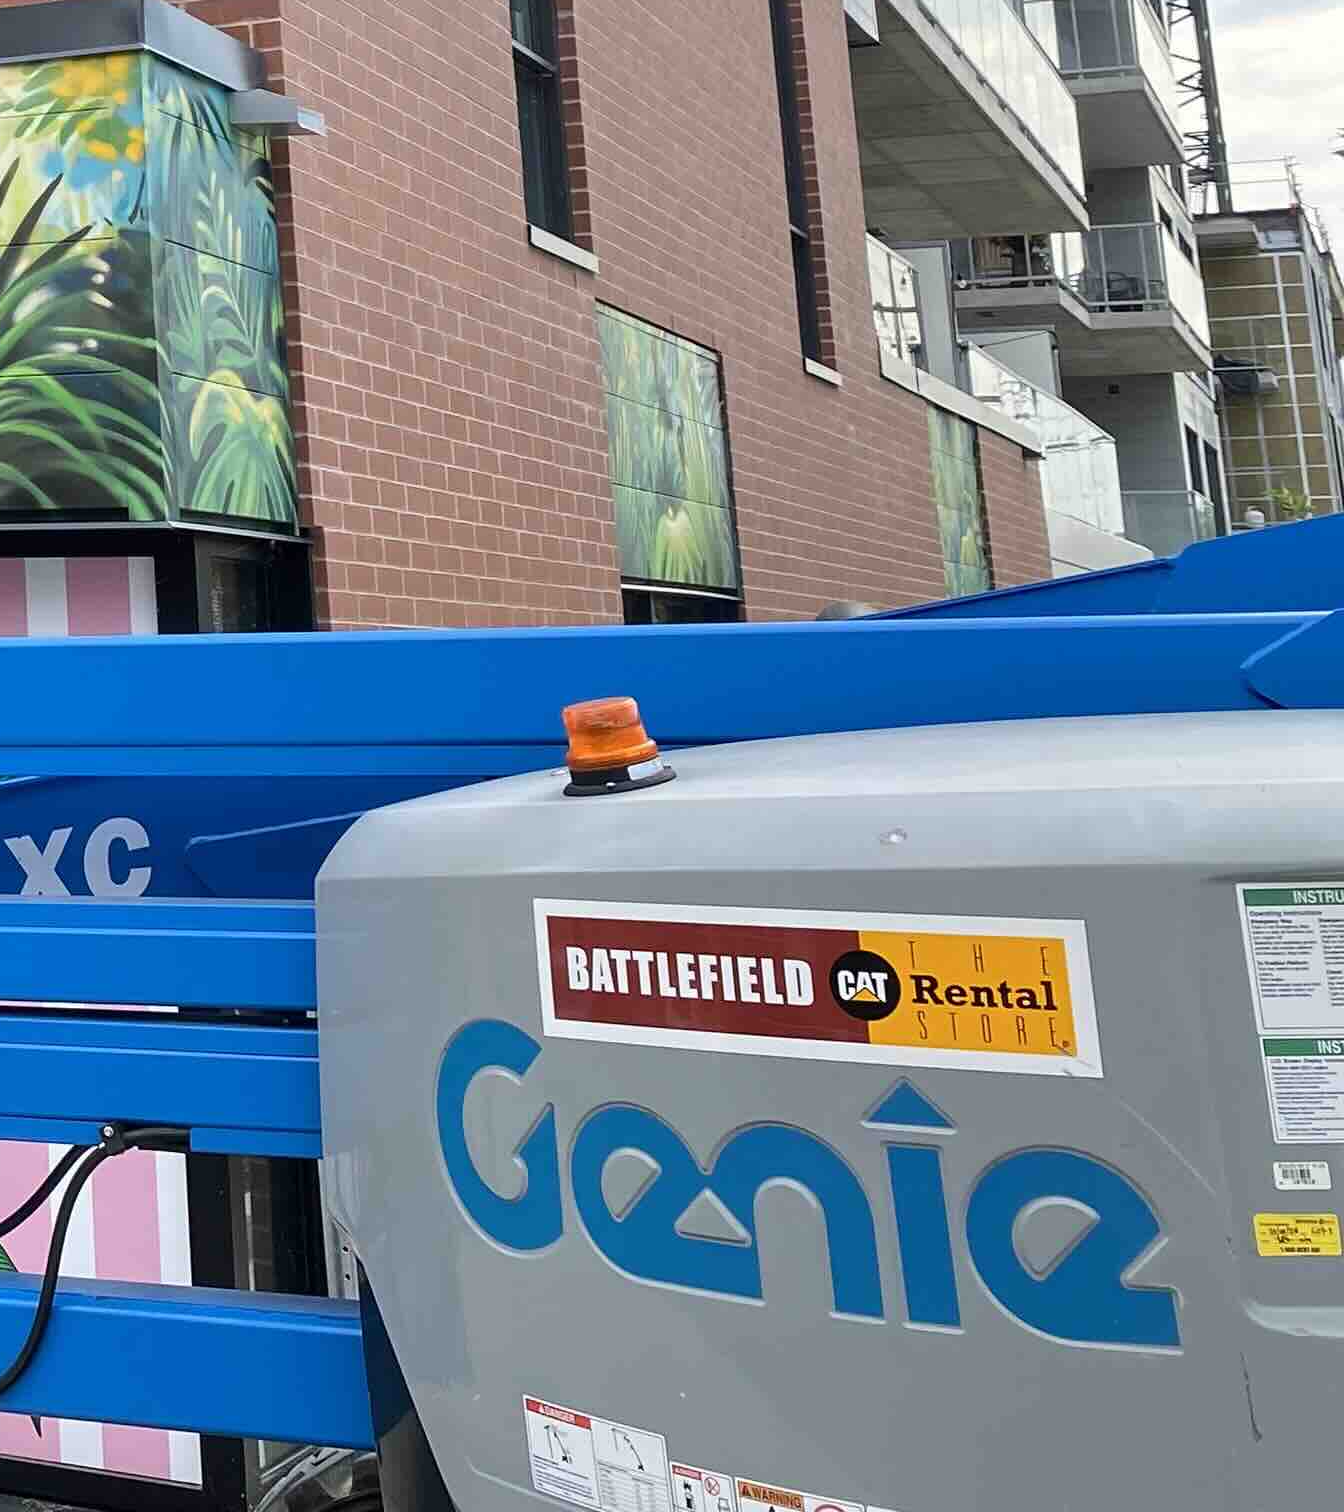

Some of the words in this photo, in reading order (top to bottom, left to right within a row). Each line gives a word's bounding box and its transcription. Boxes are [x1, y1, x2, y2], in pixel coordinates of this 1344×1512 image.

[565, 944, 814, 1007] BATTLEFIELD
[837, 968, 889, 1003] CAT
[909, 973, 1059, 1012] Rental
[907, 939, 1051, 978] THE
[916, 1009, 1061, 1050] STORE
[435, 1018, 1184, 1354] Genie
[752, 1485, 802, 1509] WARNING
